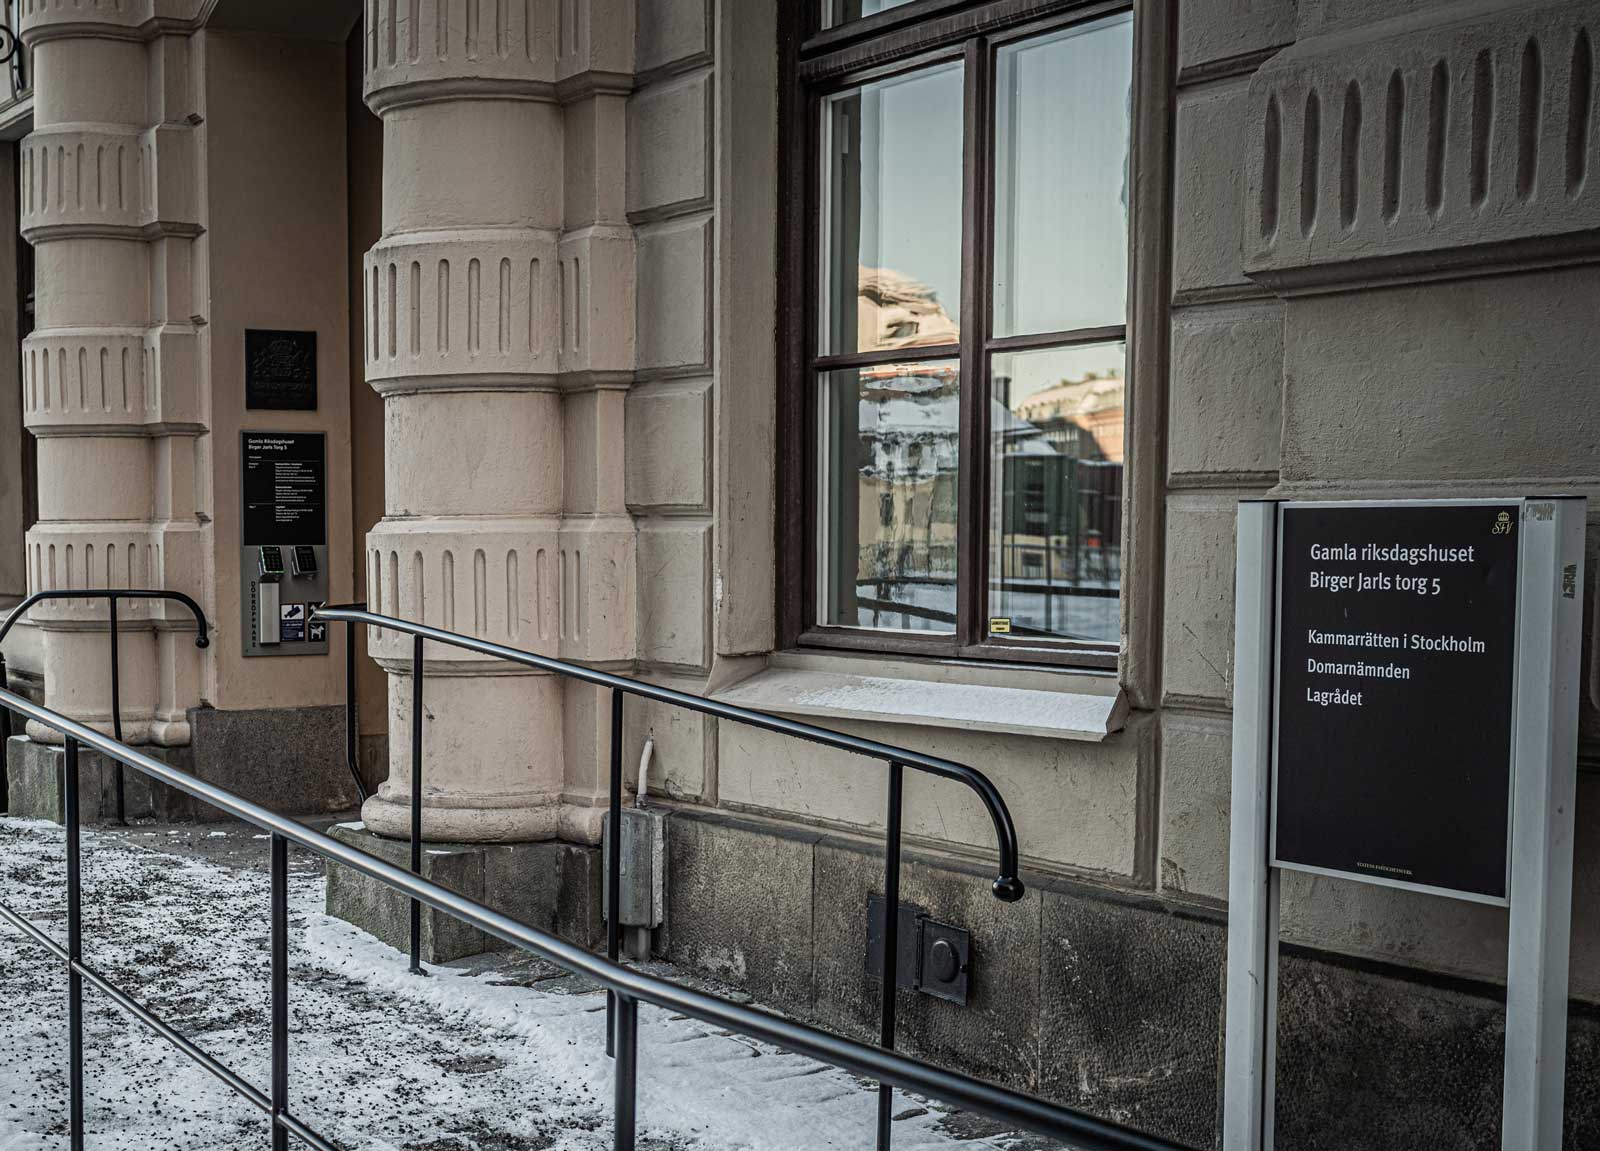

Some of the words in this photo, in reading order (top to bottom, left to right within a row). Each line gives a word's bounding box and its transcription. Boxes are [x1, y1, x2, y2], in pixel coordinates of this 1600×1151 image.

[1310, 542, 1357, 561] Gamla
[1361, 543, 1475, 566] riksdagshuset
[1309, 570, 1355, 593] Birger
[1356, 571, 1392, 592] Jarls
[1395, 573, 1428, 594] torg
[1431, 577, 1441, 596] 5
[1308, 629, 1400, 649] Kammarrätten
[1403, 633, 1408, 649] i
[1410, 634, 1486, 653] Stockholm
[1307, 658, 1410, 680] Domarnämnden
[1306, 687, 1363, 706] Lagrådet
